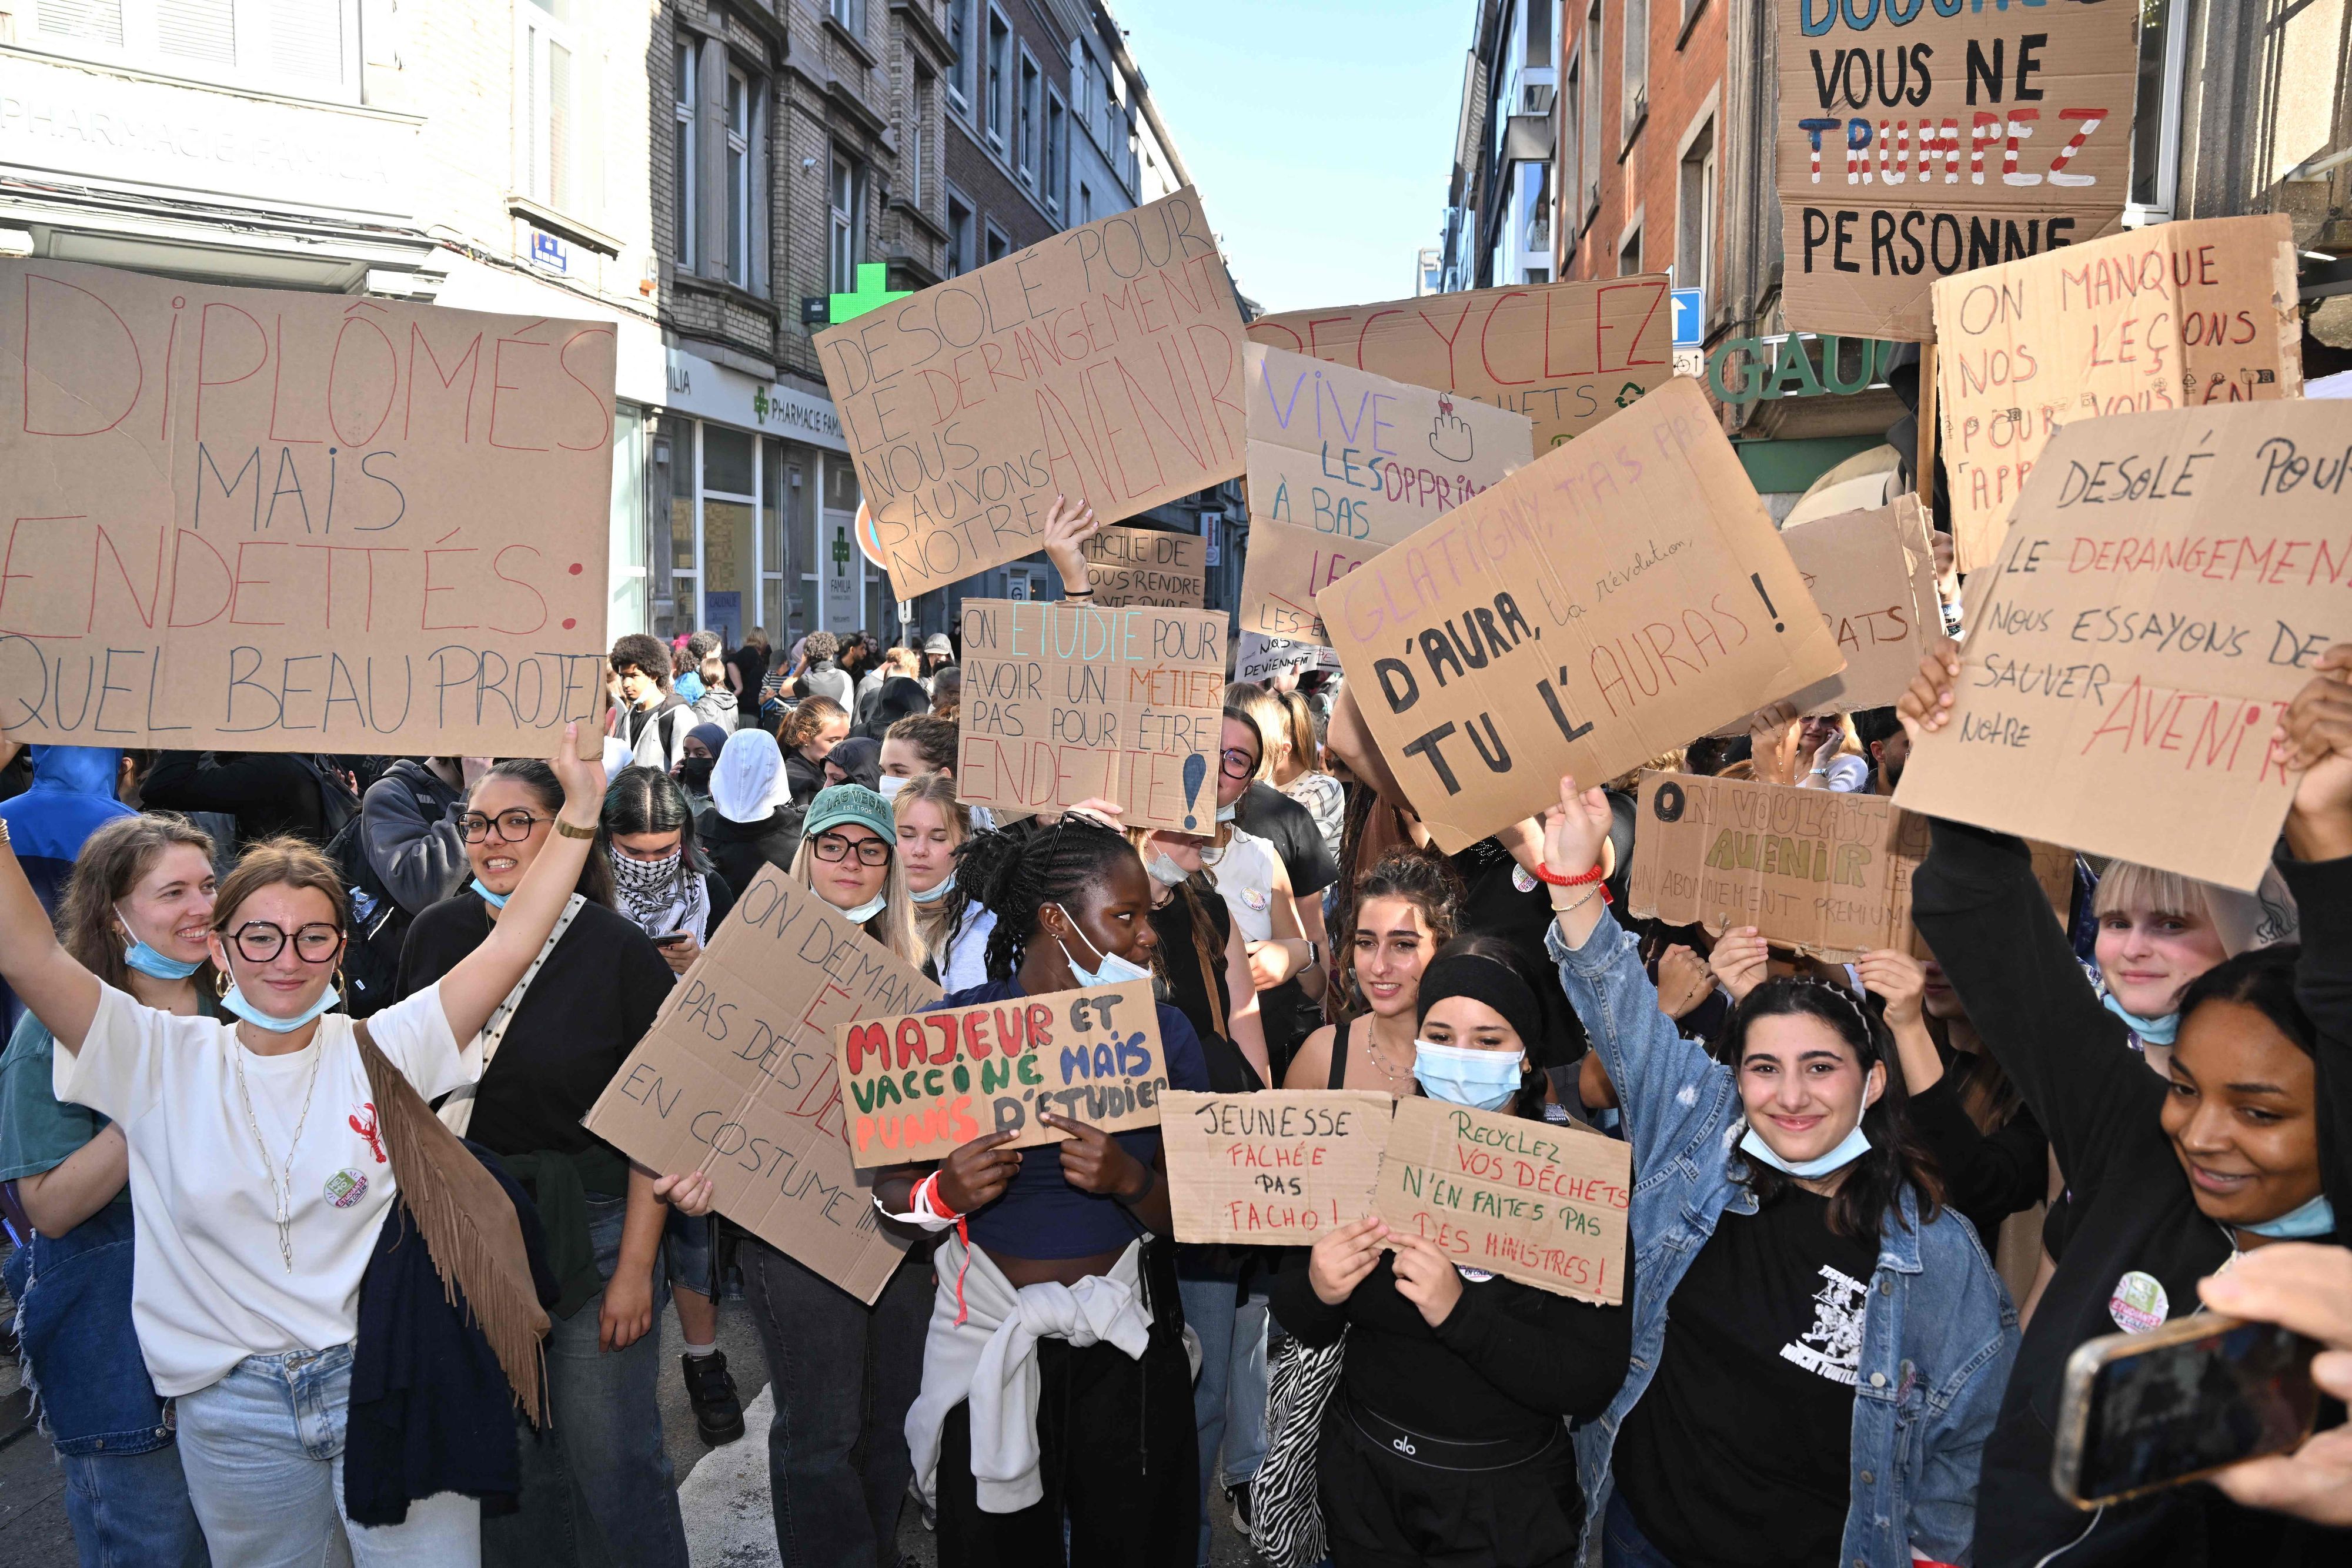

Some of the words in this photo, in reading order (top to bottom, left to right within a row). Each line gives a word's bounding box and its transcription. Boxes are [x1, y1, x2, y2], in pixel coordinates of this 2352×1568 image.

[1809, 43, 1935, 109] VOUS
[1966, 33, 2048, 105] NE
[1, 96, 235, 163] PHARMACIE
[1798, 108, 2109, 186] TRUMPEZ
[826, 253, 1056, 400] DESOLÉ
[1065, 199, 1210, 292] POUR
[1960, 279, 2023, 335] ON
[2062, 245, 2219, 312] MANQUE
[847, 386, 910, 454] LE
[916, 252, 1228, 426] DERANGEMENT
[1959, 344, 2037, 398] NOS
[2091, 310, 2256, 376] LEÇONS
[771, 397, 821, 433] PHARMACIE
[823, 414, 845, 439] FAMI
[1653, 406, 1708, 460] PAS
[863, 422, 980, 502] NOUS
[893, 493, 1046, 587] NOTRE
[1035, 325, 1246, 513] AVENIR
[1321, 440, 1386, 492] LES
[877, 449, 1049, 546] SAUVONS
[1272, 473, 1291, 524] À
[1312, 487, 1370, 540] BAS
[1155, 537, 1193, 567] DE
[2006, 536, 2050, 573] LE
[2067, 536, 2352, 588] DERANGEMEN
[1087, 569, 1130, 590] OUS
[1132, 570, 1201, 596] RENDRE
[963, 609, 997, 650] ON
[1013, 602, 1144, 662] ETUDIE
[1154, 618, 1218, 662] POUR
[1260, 603, 1300, 633] LES
[1987, 599, 2055, 635] NOUS
[2071, 606, 2250, 658] ESSAYONS
[2267, 620, 2330, 669] DE
[216, 646, 410, 734] BEAU
[428, 645, 607, 730] PROJET
[964, 660, 1043, 701] AVOIR
[1067, 665, 1106, 705] UN
[1130, 663, 1224, 708] MÉTIER
[1973, 653, 2111, 706] SAUVER
[973, 702, 1024, 737] PAS
[1052, 708, 1117, 747] POUR
[1139, 707, 1213, 752] ÊTRE
[1402, 711, 1512, 796] TU
[826, 790, 849, 812] LAS
[851, 790, 887, 820] VEGAS
[961, 736, 1179, 822] ENDETTÉ
[1653, 780, 1718, 824] ON
[857, 805, 873, 814] 1905
[1661, 870, 1802, 917] ABONNEMENT
[742, 879, 804, 939] ON
[797, 917, 934, 1015] DEMAN
[678, 979, 738, 1041] PAS
[732, 1019, 814, 1091] DES
[846, 1002, 1054, 1076] MAJEUR
[1069, 994, 1124, 1033] ET
[620, 1062, 682, 1119] EN
[690, 1110, 855, 1227] COSTUME
[1195, 1101, 1352, 1137] JEUNESSE
[1449, 1110, 1561, 1165] RECYCLEZ
[328, 1176, 346, 1188] HEL
[1226, 1141, 1327, 1168] FACHÉE
[1457, 1144, 1504, 1180] VOS
[1514, 1161, 1629, 1209] DÉCHETS
[333, 1181, 348, 1193] MO
[346, 1199, 353, 1207] EN
[1255, 1174, 1301, 1196] PAS
[1403, 1165, 1463, 1209] N'EN
[1559, 1206, 1602, 1236] PAS
[1393, 1435, 1416, 1455] alo
